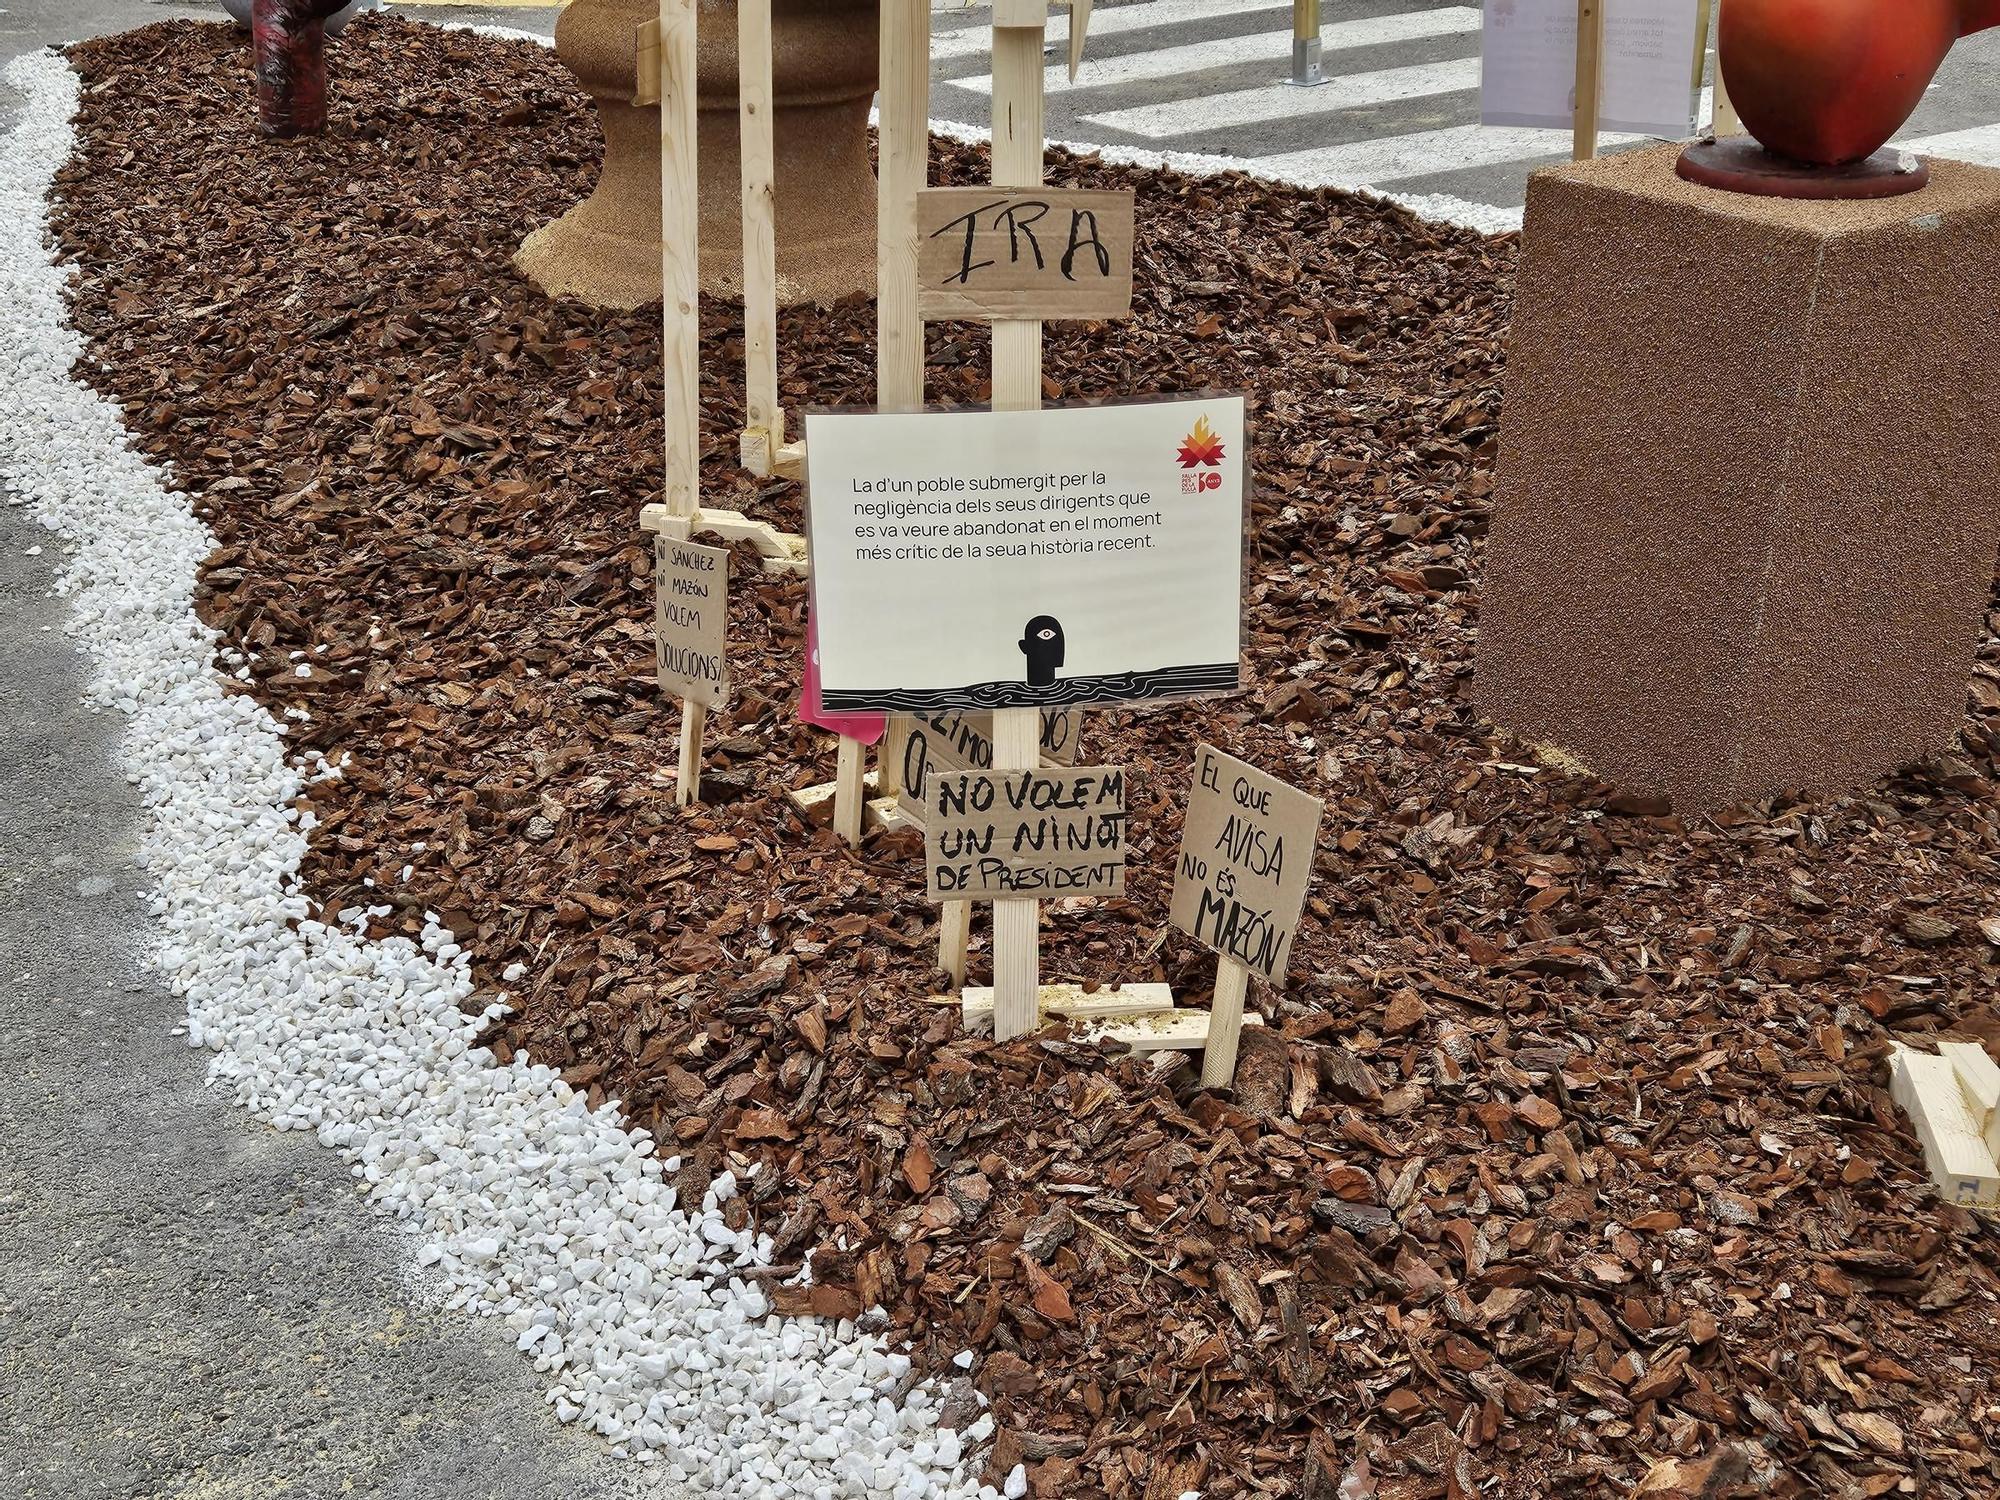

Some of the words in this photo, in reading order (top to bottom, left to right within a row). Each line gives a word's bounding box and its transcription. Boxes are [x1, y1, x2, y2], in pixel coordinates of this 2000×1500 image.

[930, 200, 1110, 284] IRA
[853, 479, 872, 492] La
[876, 478, 912, 492] d'un
[917, 477, 964, 496] poble
[969, 473, 1055, 492] submergit
[1061, 475, 1087, 491] per
[1093, 471, 1105, 484] la
[855, 499, 951, 519] negligència
[956, 499, 991, 513] dels
[996, 500, 1036, 512] seus
[1040, 494, 1114, 513] dirigents
[1119, 493, 1150, 509] que
[855, 526, 875, 537] es
[879, 526, 897, 537] va
[902, 525, 949, 537] veure
[954, 519, 1045, 536] abandonat
[1050, 521, 1070, 532] en
[1075, 516, 1088, 530] el
[1094, 512, 1161, 529] moment
[671, 545, 714, 571] SÁNCHEZ
[857, 545, 891, 559] més
[896, 544, 937, 559] crític
[942, 545, 963, 558] de
[968, 544, 981, 557] la
[986, 545, 1026, 557] seua
[1031, 539, 1093, 555] història
[1098, 535, 1155, 551] recent.
[672, 578, 708, 598] MAZÓN
[663, 600, 700, 630] VOLEM
[939, 775, 994, 817] NO
[1005, 771, 1122, 811] VOLEM
[1201, 754, 1220, 794] EL
[1233, 777, 1272, 816] QUE
[940, 824, 995, 859] UN
[1013, 812, 1123, 853] NINOT
[1215, 815, 1285, 886] AVISA
[936, 865, 968, 891] DE
[977, 858, 1124, 891] PRESIDENT
[1181, 852, 1207, 880] NO
[1194, 886, 1285, 976] MAZÓN
